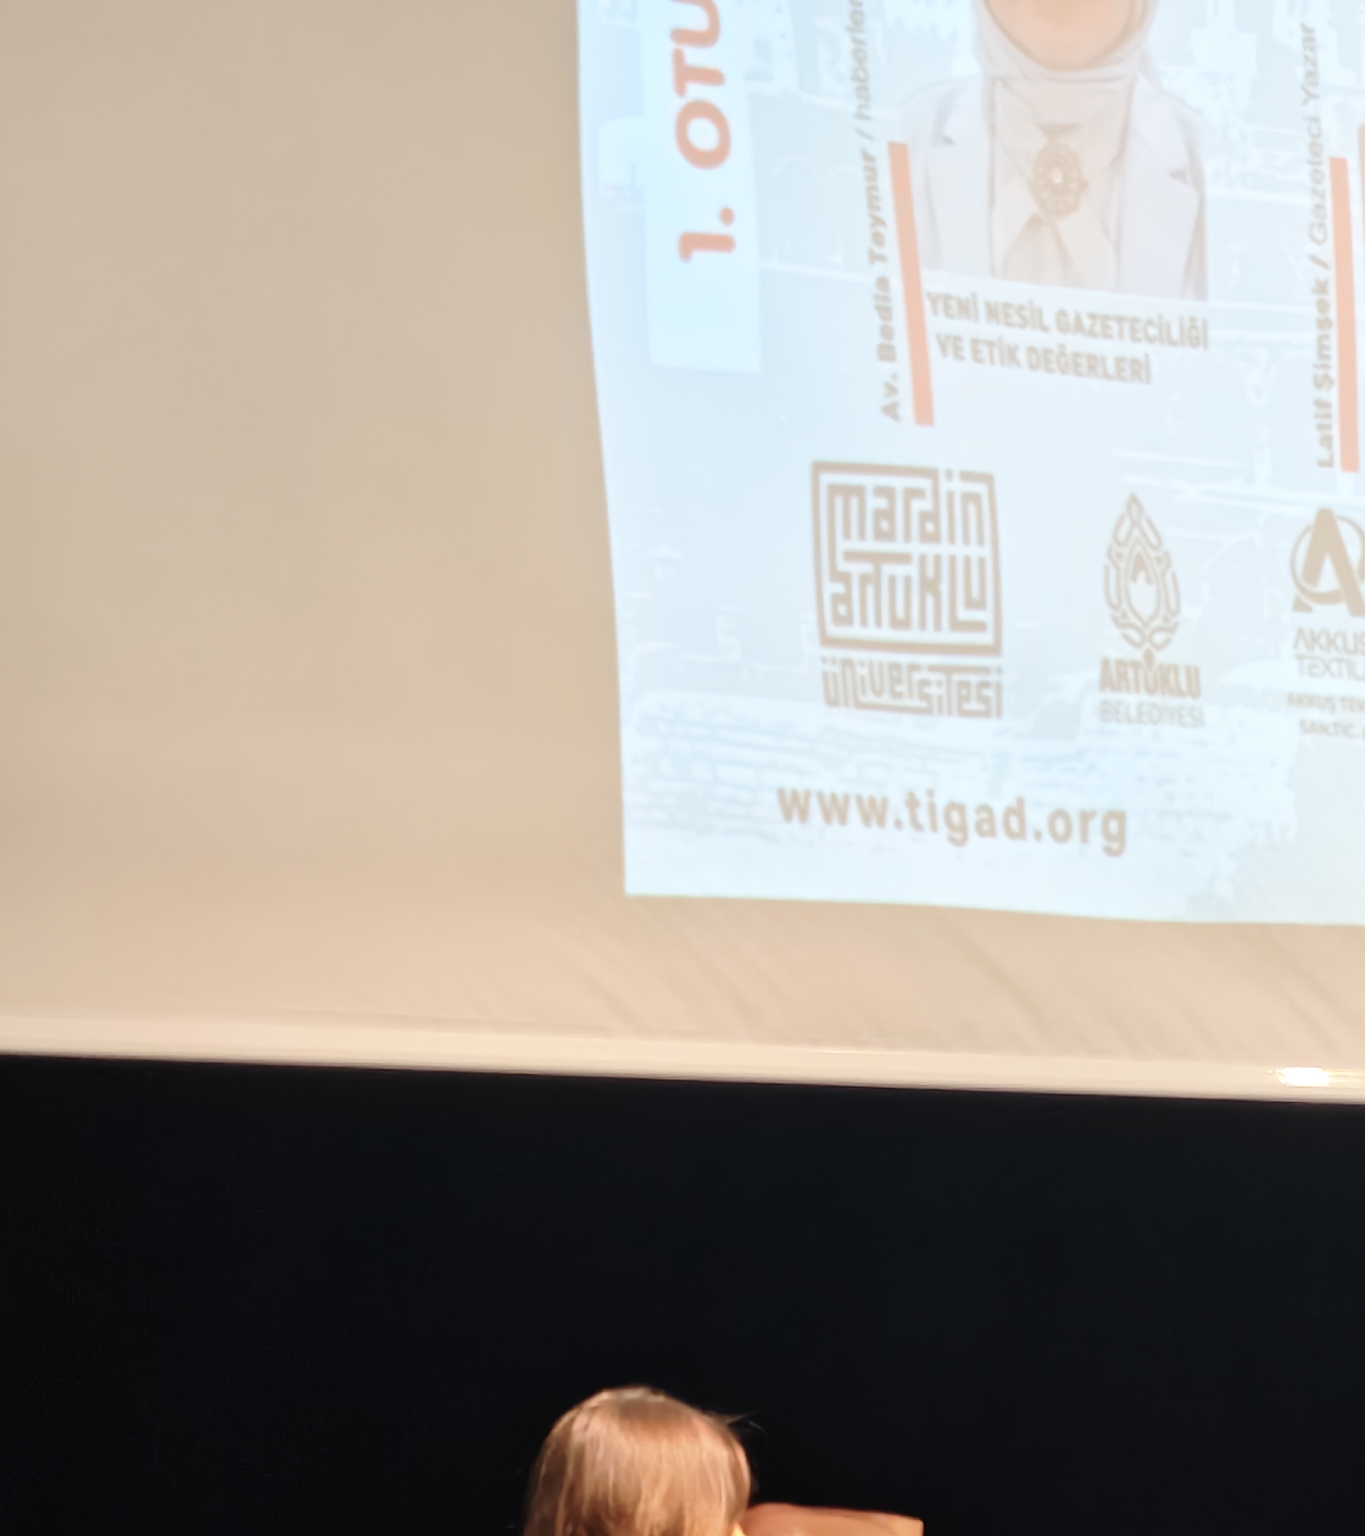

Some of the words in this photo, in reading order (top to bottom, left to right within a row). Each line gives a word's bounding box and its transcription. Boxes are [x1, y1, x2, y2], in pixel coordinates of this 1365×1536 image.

[1300, 22, 1320, 104] Yazar
[859, 147, 889, 267] Teymur
[1304, 115, 1329, 246] Gazeteci
[676, 205, 737, 263] 1.
[873, 275, 898, 363] Bedia
[926, 290, 979, 324] YENİ
[984, 299, 1050, 333] NESİL
[935, 332, 966, 362] VE
[969, 335, 1022, 369] ETİK
[1025, 343, 1151, 385] DEĞERLERİ
[878, 372, 902, 424] Av.
[1098, 656, 1202, 700] ARTUKLU
[777, 788, 1128, 859] www.tigad.org
